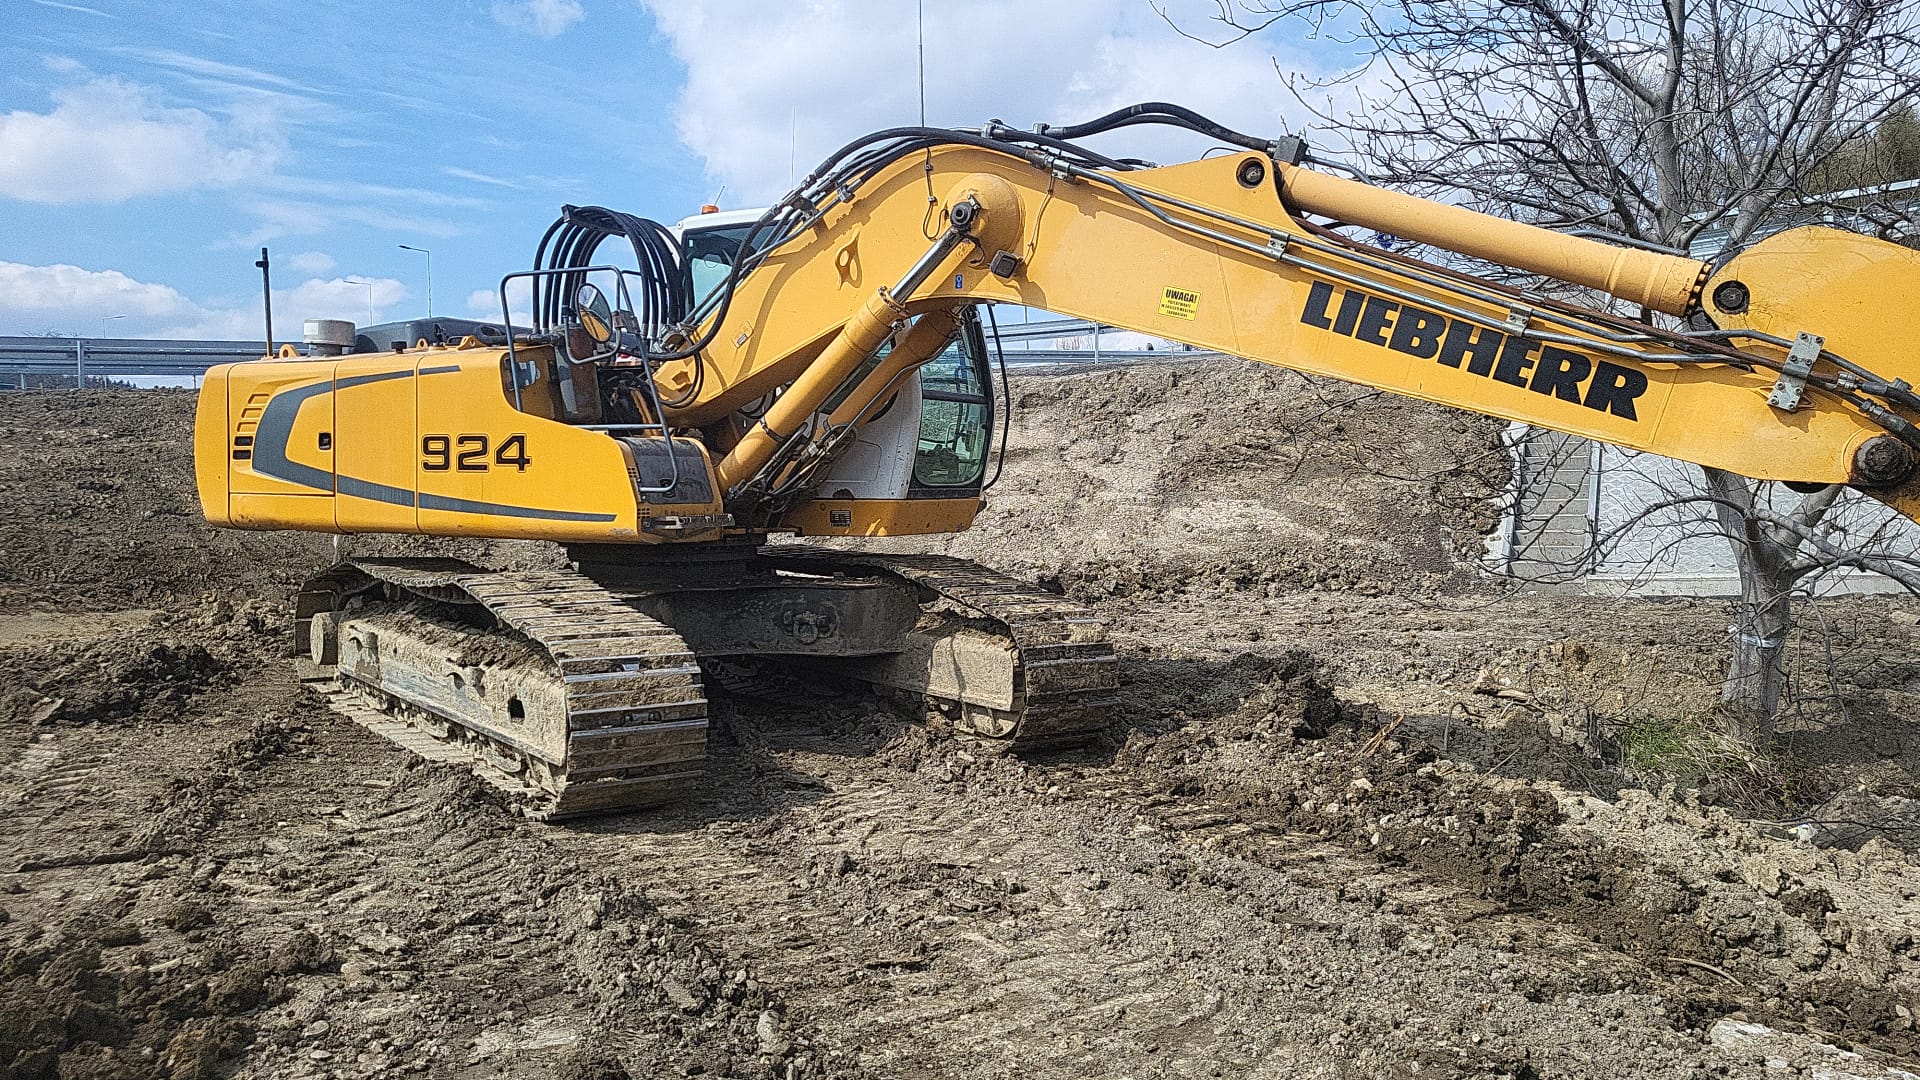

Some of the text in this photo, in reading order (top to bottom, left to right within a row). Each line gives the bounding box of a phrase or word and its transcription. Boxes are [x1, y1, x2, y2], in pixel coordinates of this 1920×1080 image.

[1165, 289, 1198, 303] UWAGA!
[1300, 280, 1648, 422] LIEBHERR
[421, 434, 532, 473] 924
